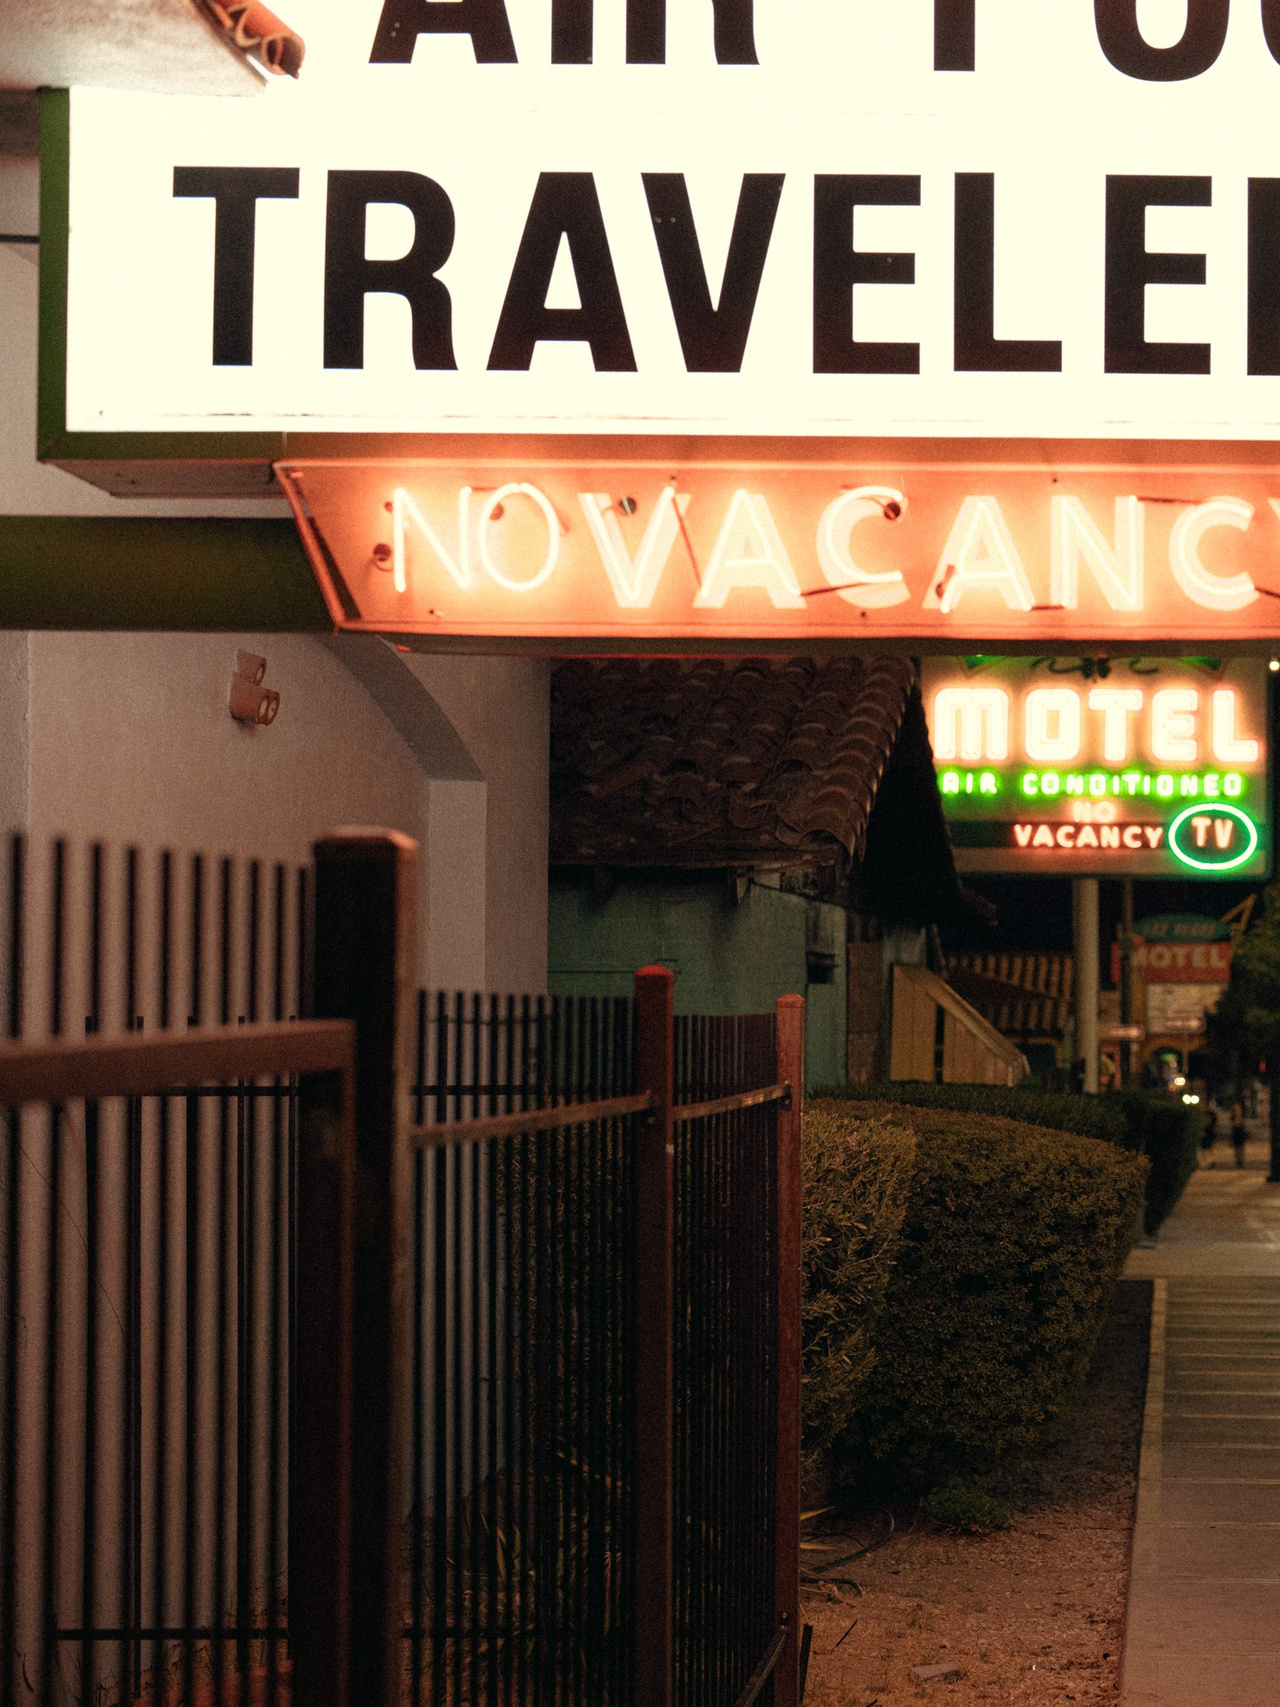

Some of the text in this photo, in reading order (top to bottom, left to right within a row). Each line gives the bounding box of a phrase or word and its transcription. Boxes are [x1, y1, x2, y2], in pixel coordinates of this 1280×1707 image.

[394, 482, 560, 592] NO
[934, 688, 1258, 761] MOTEL
[942, 771, 1242, 796] AIR CONDITIONED
[1072, 801, 1116, 823] NO
[1014, 824, 1163, 848] VACANCY
[1191, 816, 1233, 848] TV
